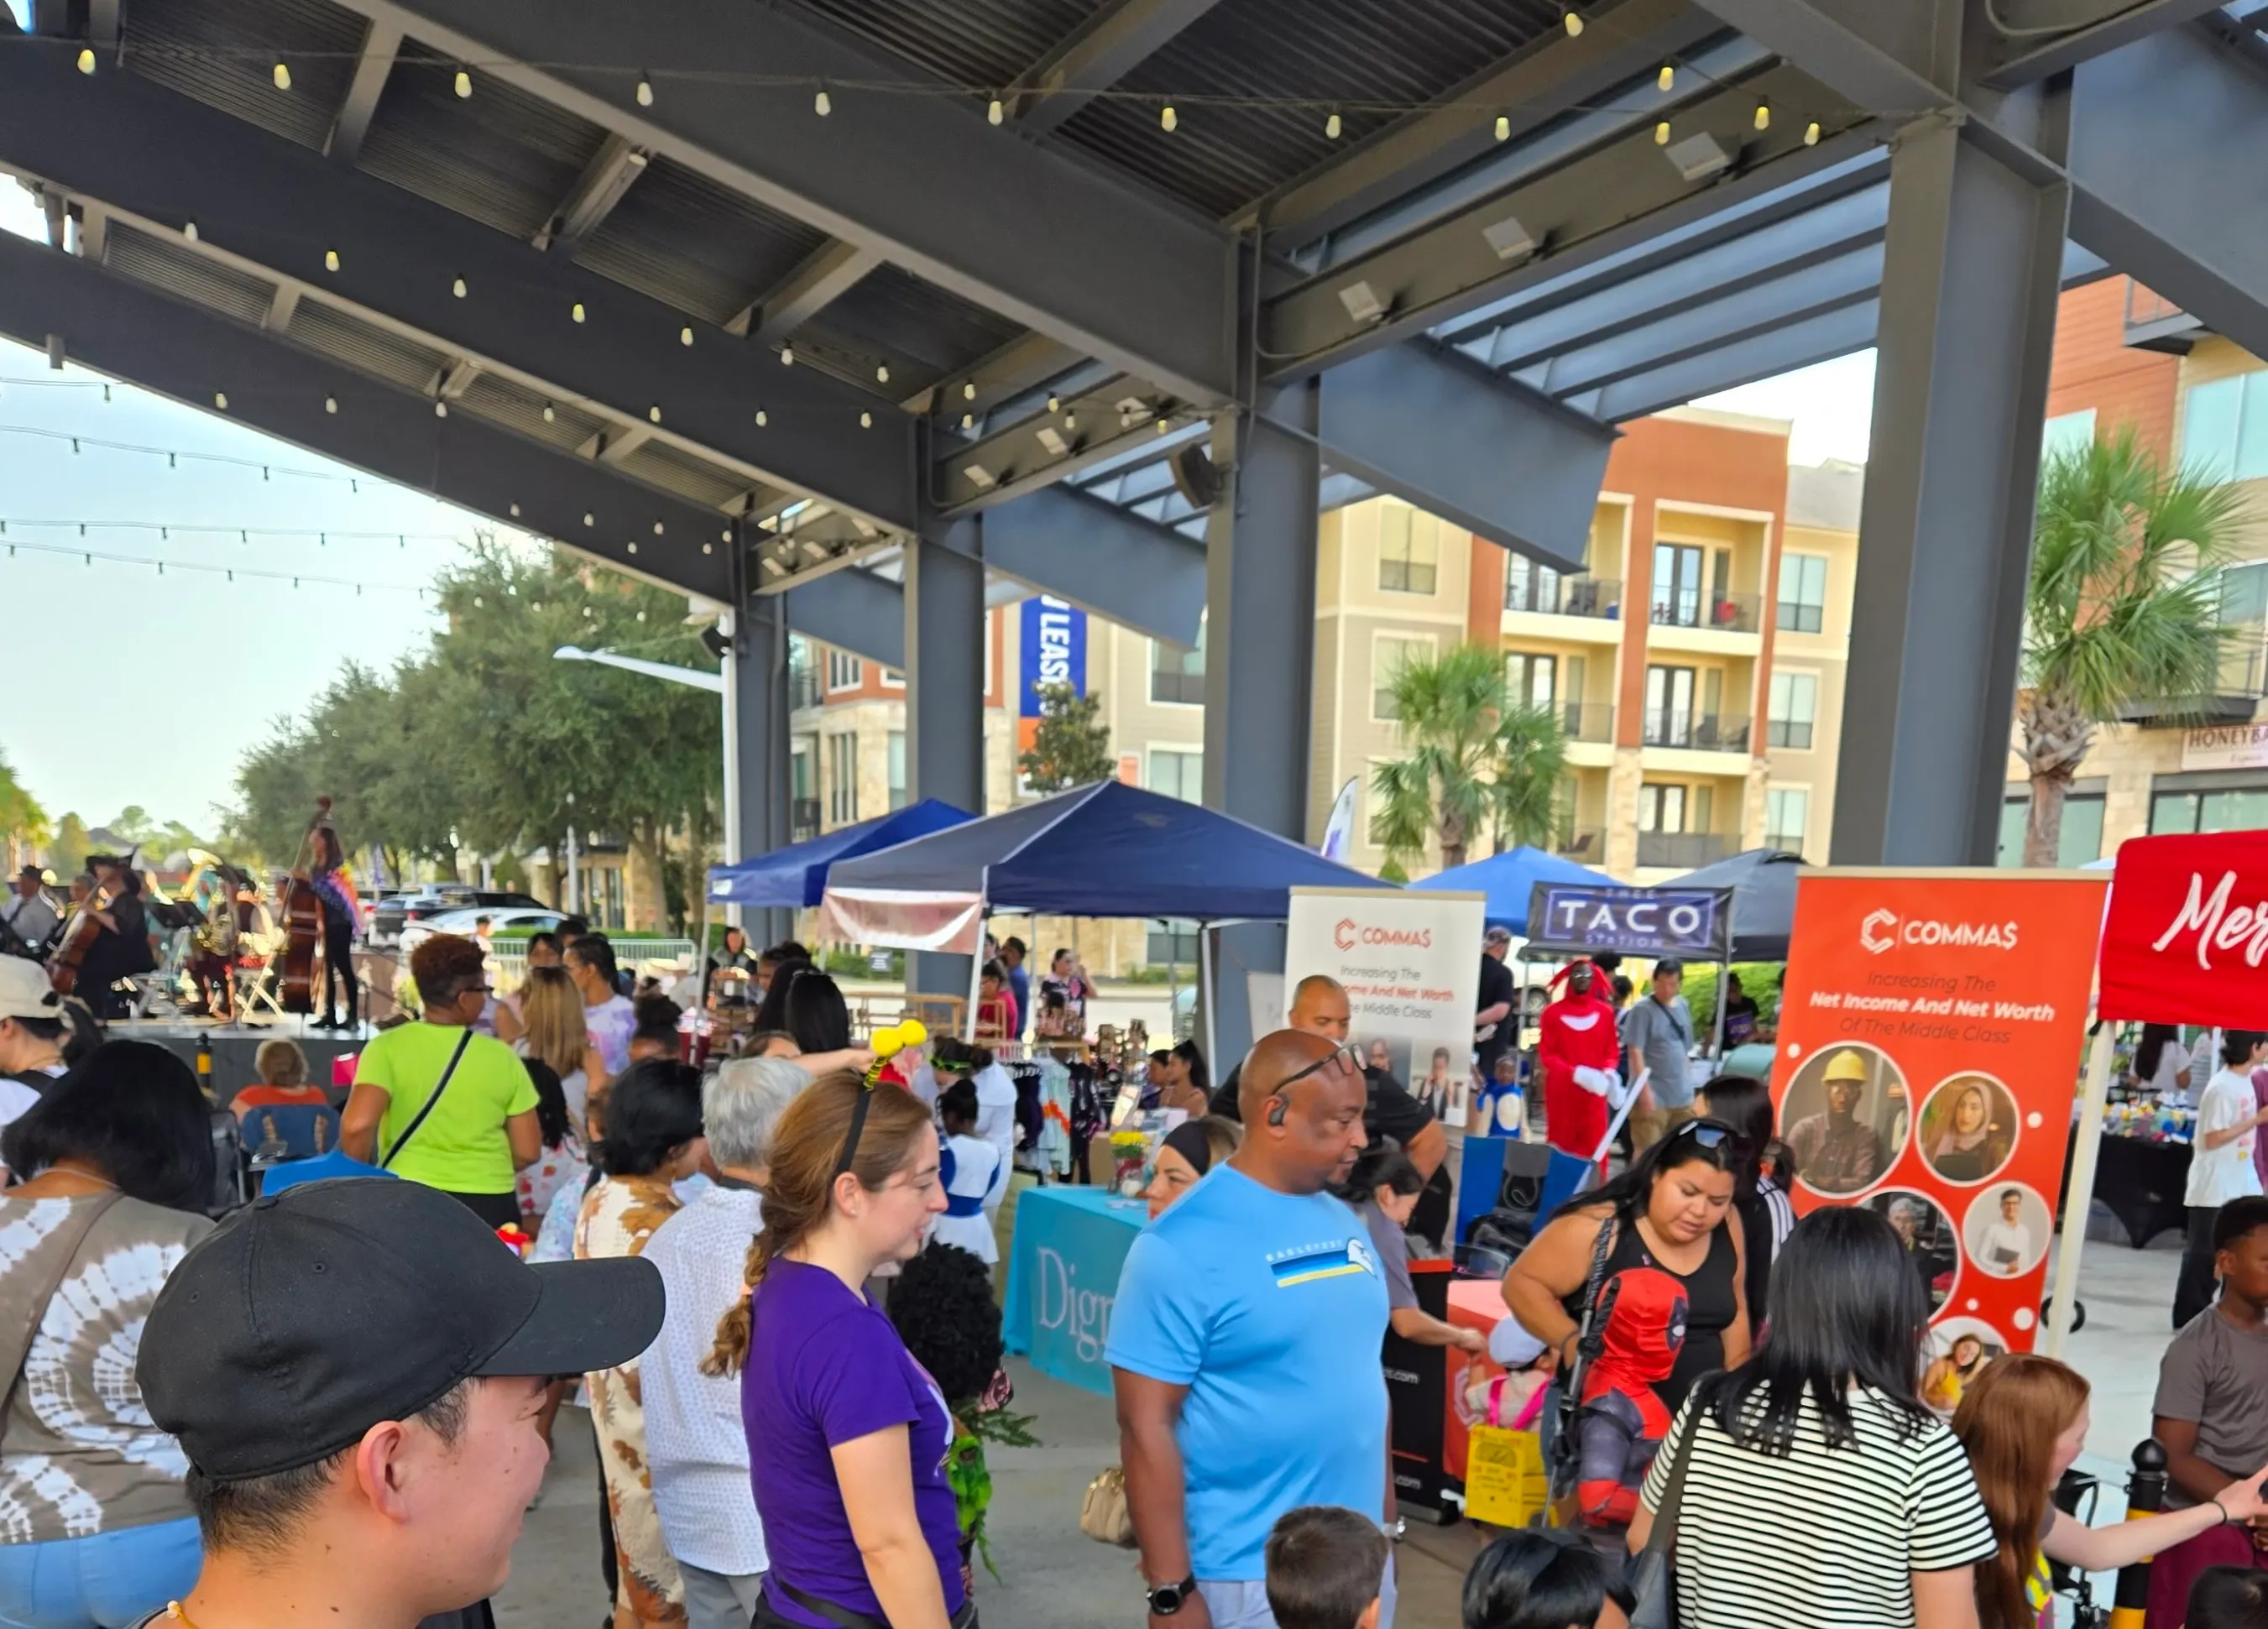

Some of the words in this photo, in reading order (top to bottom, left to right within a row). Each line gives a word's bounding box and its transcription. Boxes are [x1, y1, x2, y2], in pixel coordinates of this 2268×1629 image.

[1039, 612, 1070, 716] LEASI
[1558, 900, 1701, 934] TACO
[1586, 934, 1664, 948] STATION
[1340, 965, 1398, 982] Increasing
[1400, 969, 1421, 980] The
[1867, 972, 1958, 993] Increasing
[1964, 975, 1996, 992] The
[1370, 984, 1393, 998] And
[1398, 987, 1416, 999] Net
[1420, 988, 1455, 1001] Worth
[1362, 1003, 1400, 1017] Middle
[1403, 1005, 1433, 1019] Class
[1810, 991, 1841, 1008] Net
[1844, 993, 1910, 1012] Income
[1910, 997, 1952, 1016] And
[1954, 1000, 1989, 1017] Net
[1994, 1001, 2055, 1021] Worth
[1840, 1017, 1860, 1032] Of
[1864, 1019, 1894, 1036] The
[1899, 1021, 1958, 1040] Middle
[1963, 1025, 2012, 1043] Class
